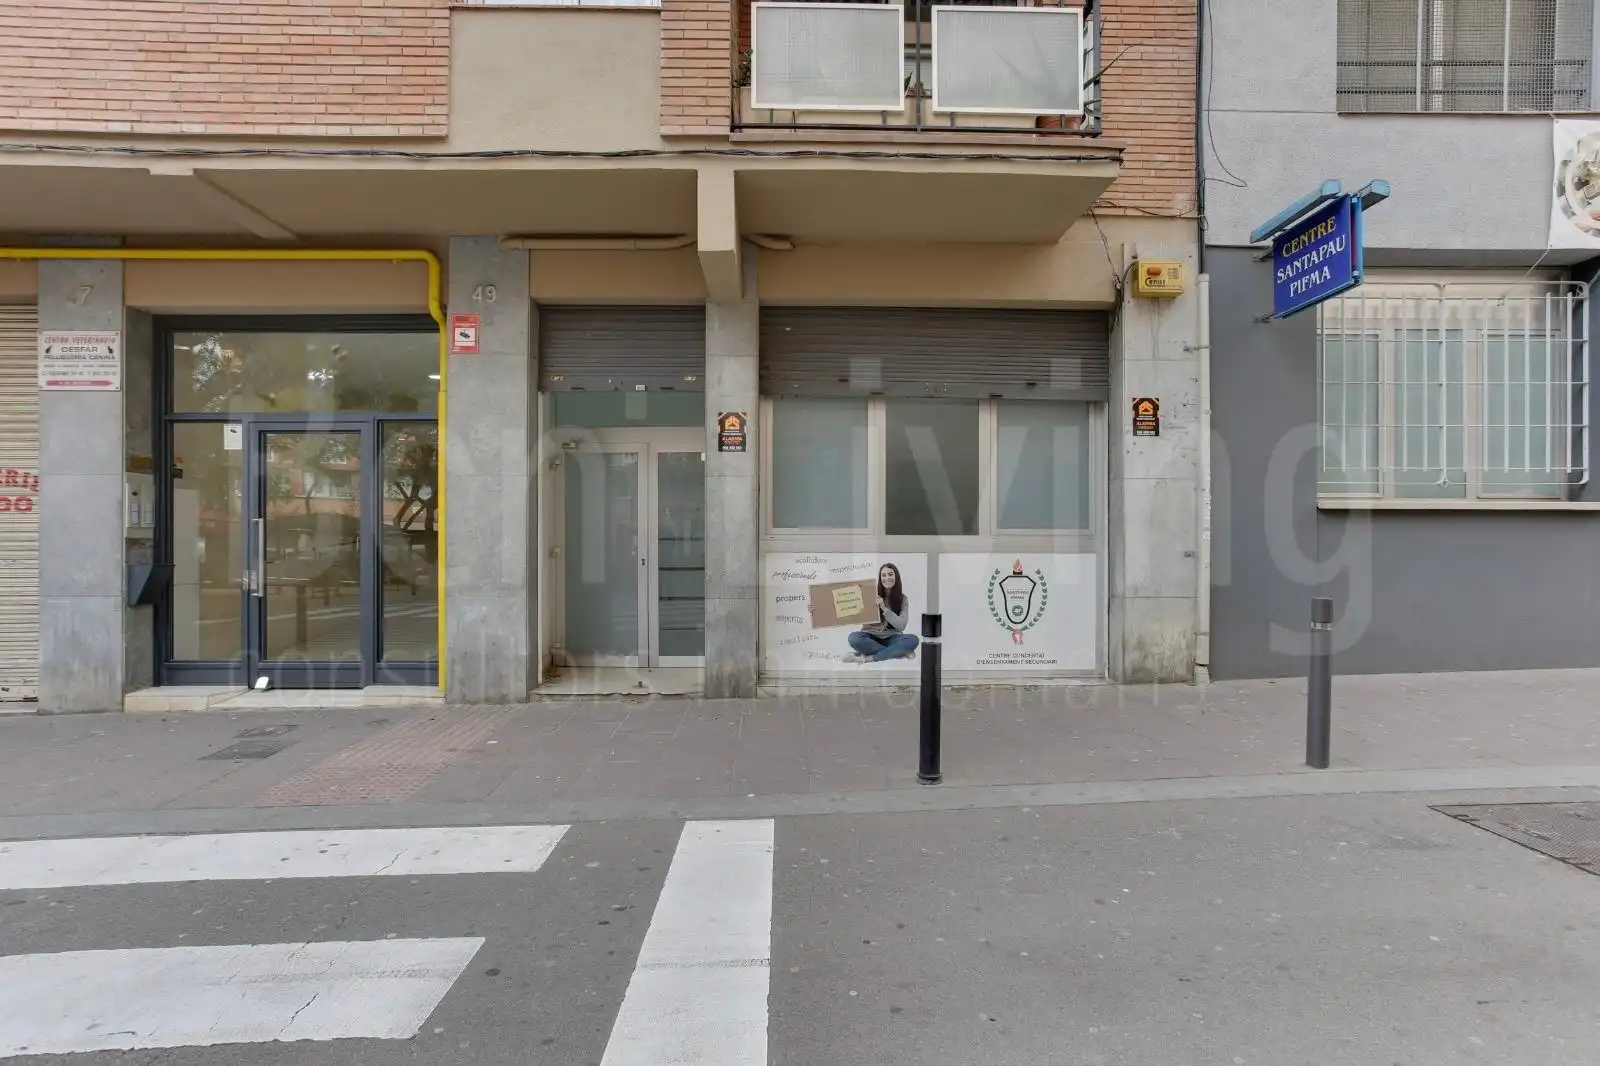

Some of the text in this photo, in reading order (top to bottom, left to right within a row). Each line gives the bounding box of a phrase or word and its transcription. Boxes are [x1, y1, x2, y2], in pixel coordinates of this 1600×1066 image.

[1283, 216, 1336, 257] CENTRE
[1277, 234, 1346, 283] SANTAPAU
[472, 285, 497, 303] 49
[1289, 265, 1332, 297] PIFMA
